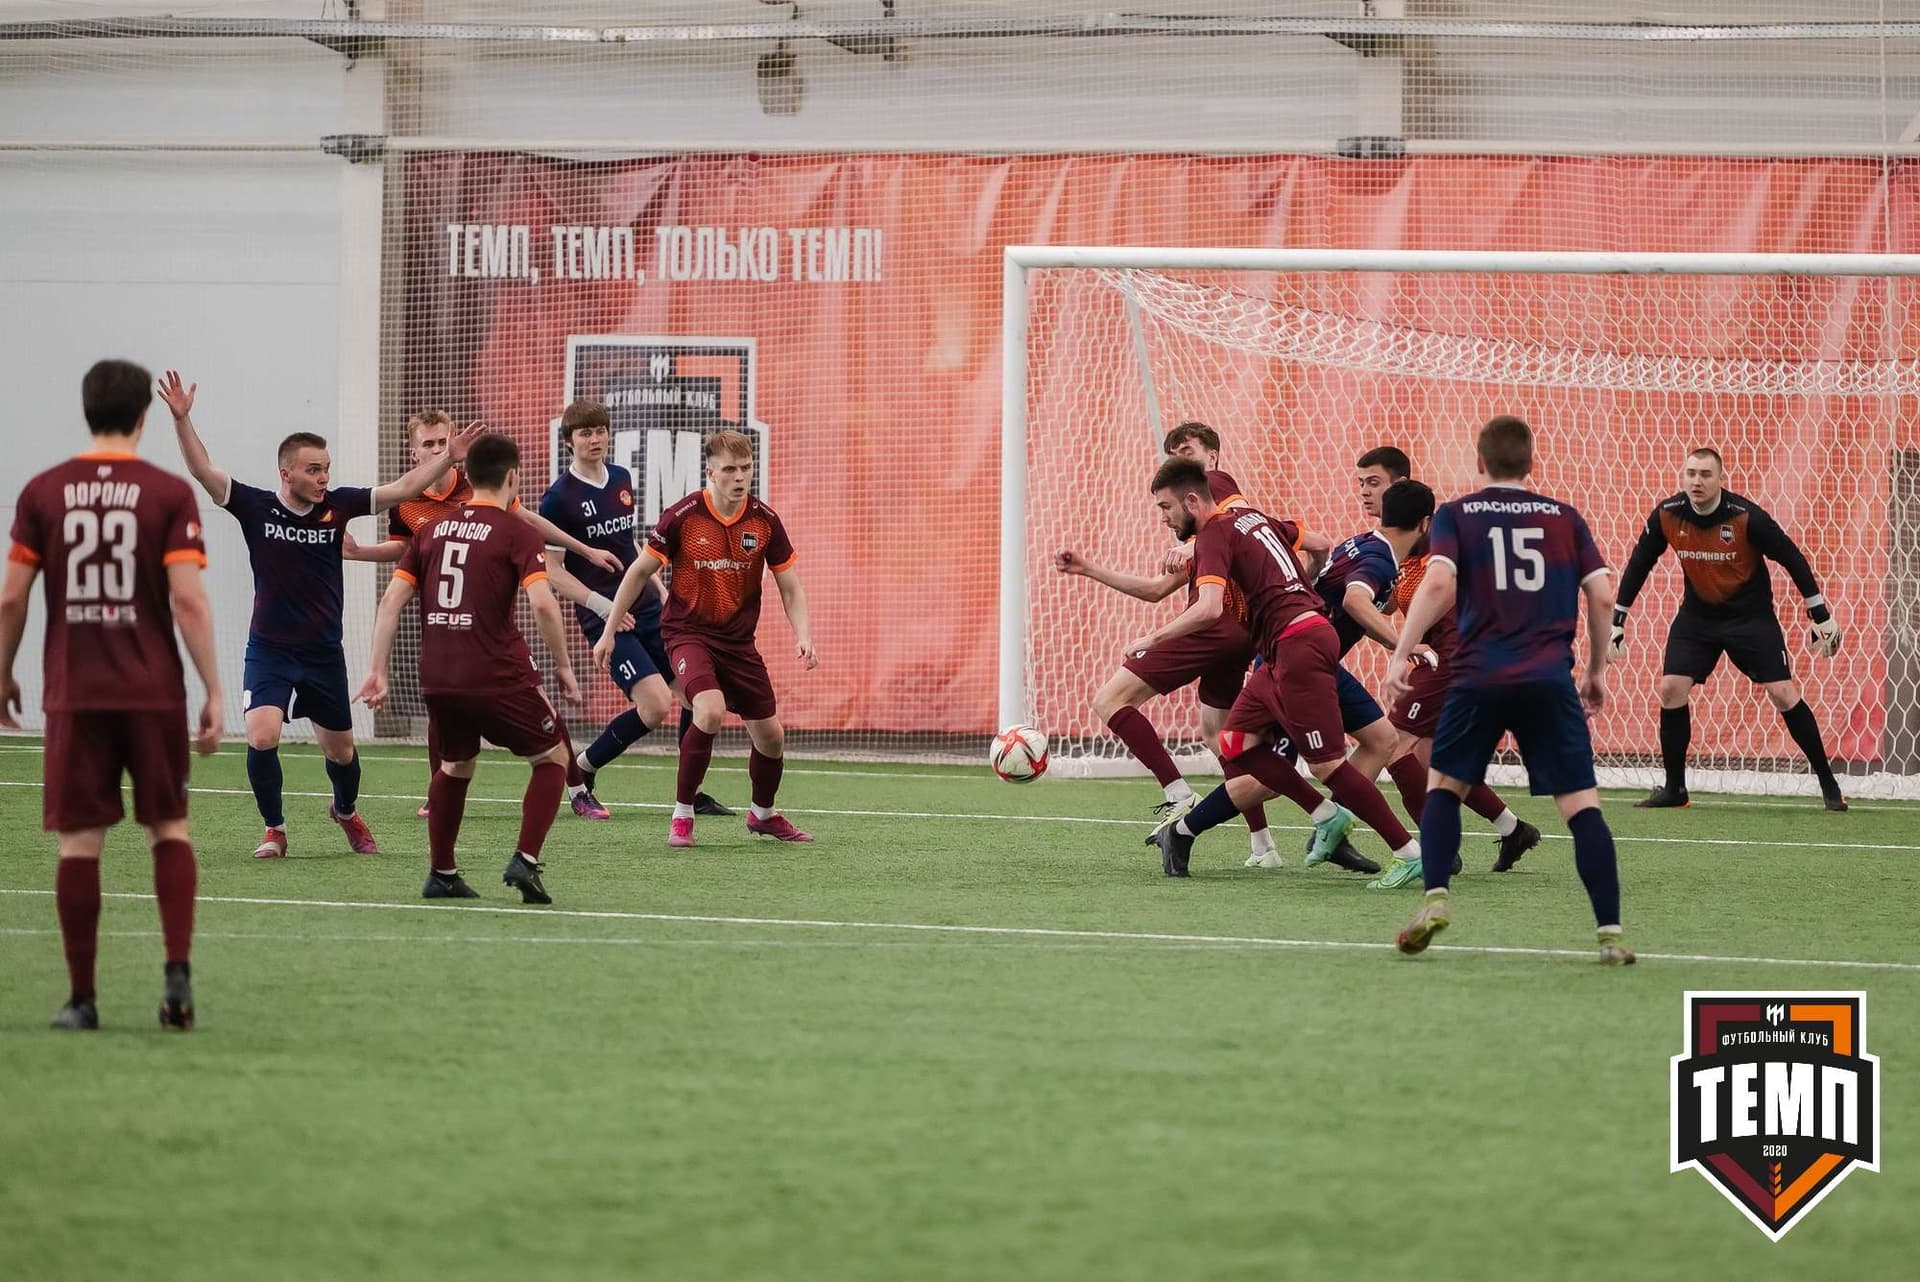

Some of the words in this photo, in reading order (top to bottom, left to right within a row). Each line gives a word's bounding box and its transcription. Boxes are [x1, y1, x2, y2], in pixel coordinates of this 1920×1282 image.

[447, 224, 538, 285] ТЕМП,
[551, 226, 645, 286] ТЕМП,
[656, 225, 778, 282] ТОЛЬКО
[788, 227, 882, 282] ТЕМП!
[64, 481, 141, 510] ВОРОНА
[581, 500, 597, 517] 31
[1462, 501, 1562, 516] КРАСНОЯРСК
[264, 522, 336, 544] РАССВЕТ
[433, 520, 492, 541] БОРИСОВ
[63, 509, 138, 600] 23
[1252, 525, 1298, 582] 10
[1488, 526, 1545, 591] 15
[437, 540, 470, 609] 5
[65, 604, 137, 623] SEUS
[427, 612, 473, 625] SEUS
[619, 659, 637, 680] 31
[1407, 702, 1421, 720] 8
[1305, 730, 1324, 750] 10
